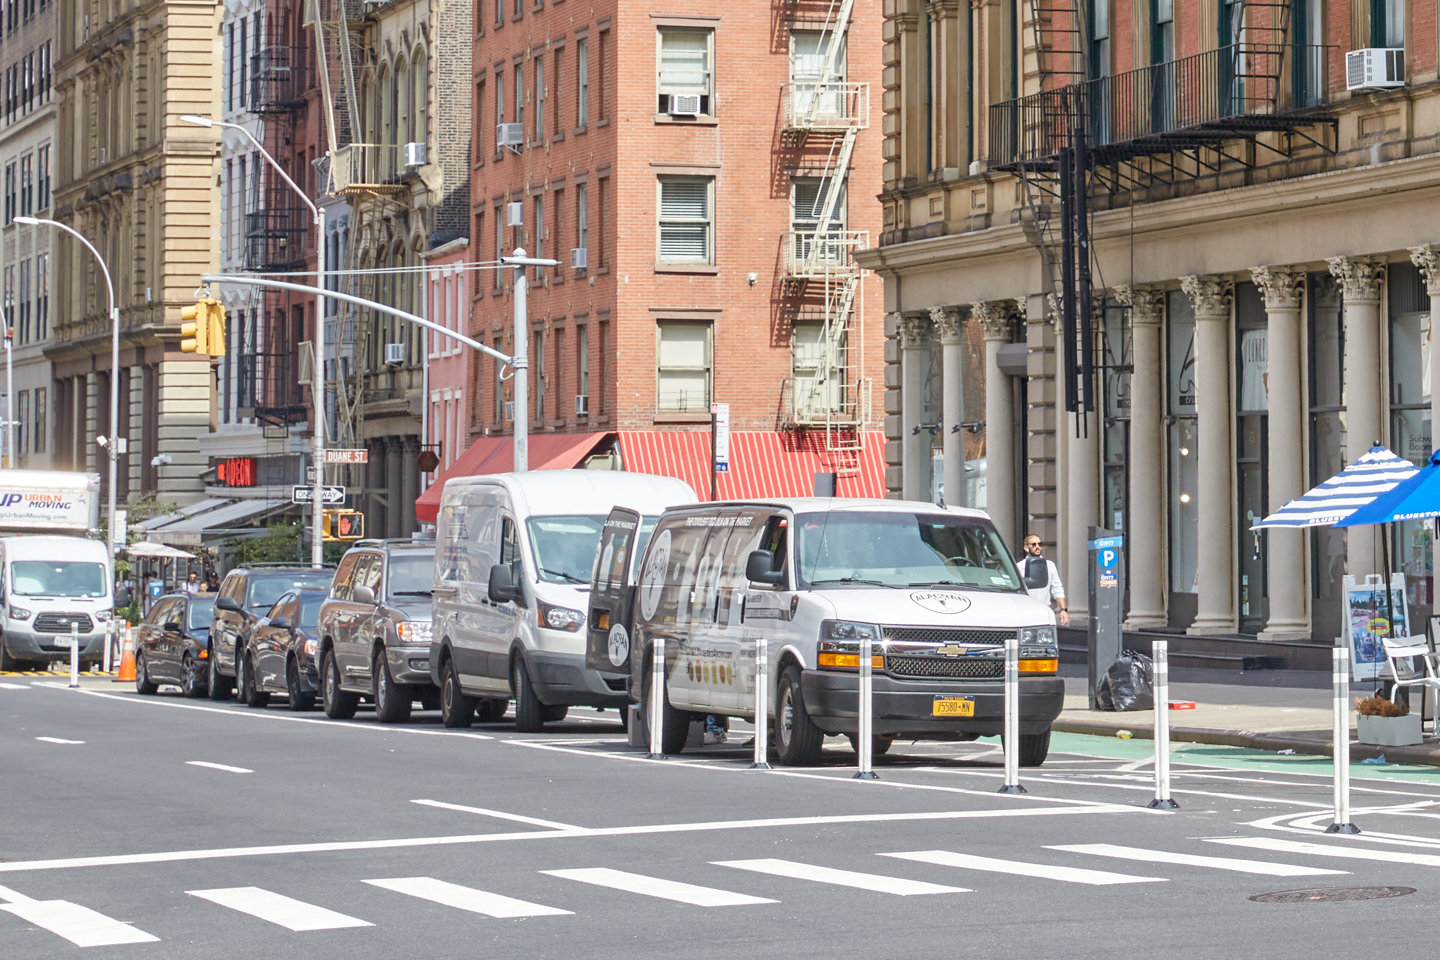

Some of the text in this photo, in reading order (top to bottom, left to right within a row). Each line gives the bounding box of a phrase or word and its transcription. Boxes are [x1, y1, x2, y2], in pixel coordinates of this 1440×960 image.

[328, 451, 364, 462] DUANE ST
[226, 458, 252, 486] ODEON
[24, 493, 62, 502] URBAN
[297, 490, 314, 499] ONE
[28, 500, 72, 510] MOVING
[1103, 550, 1115, 567] P
